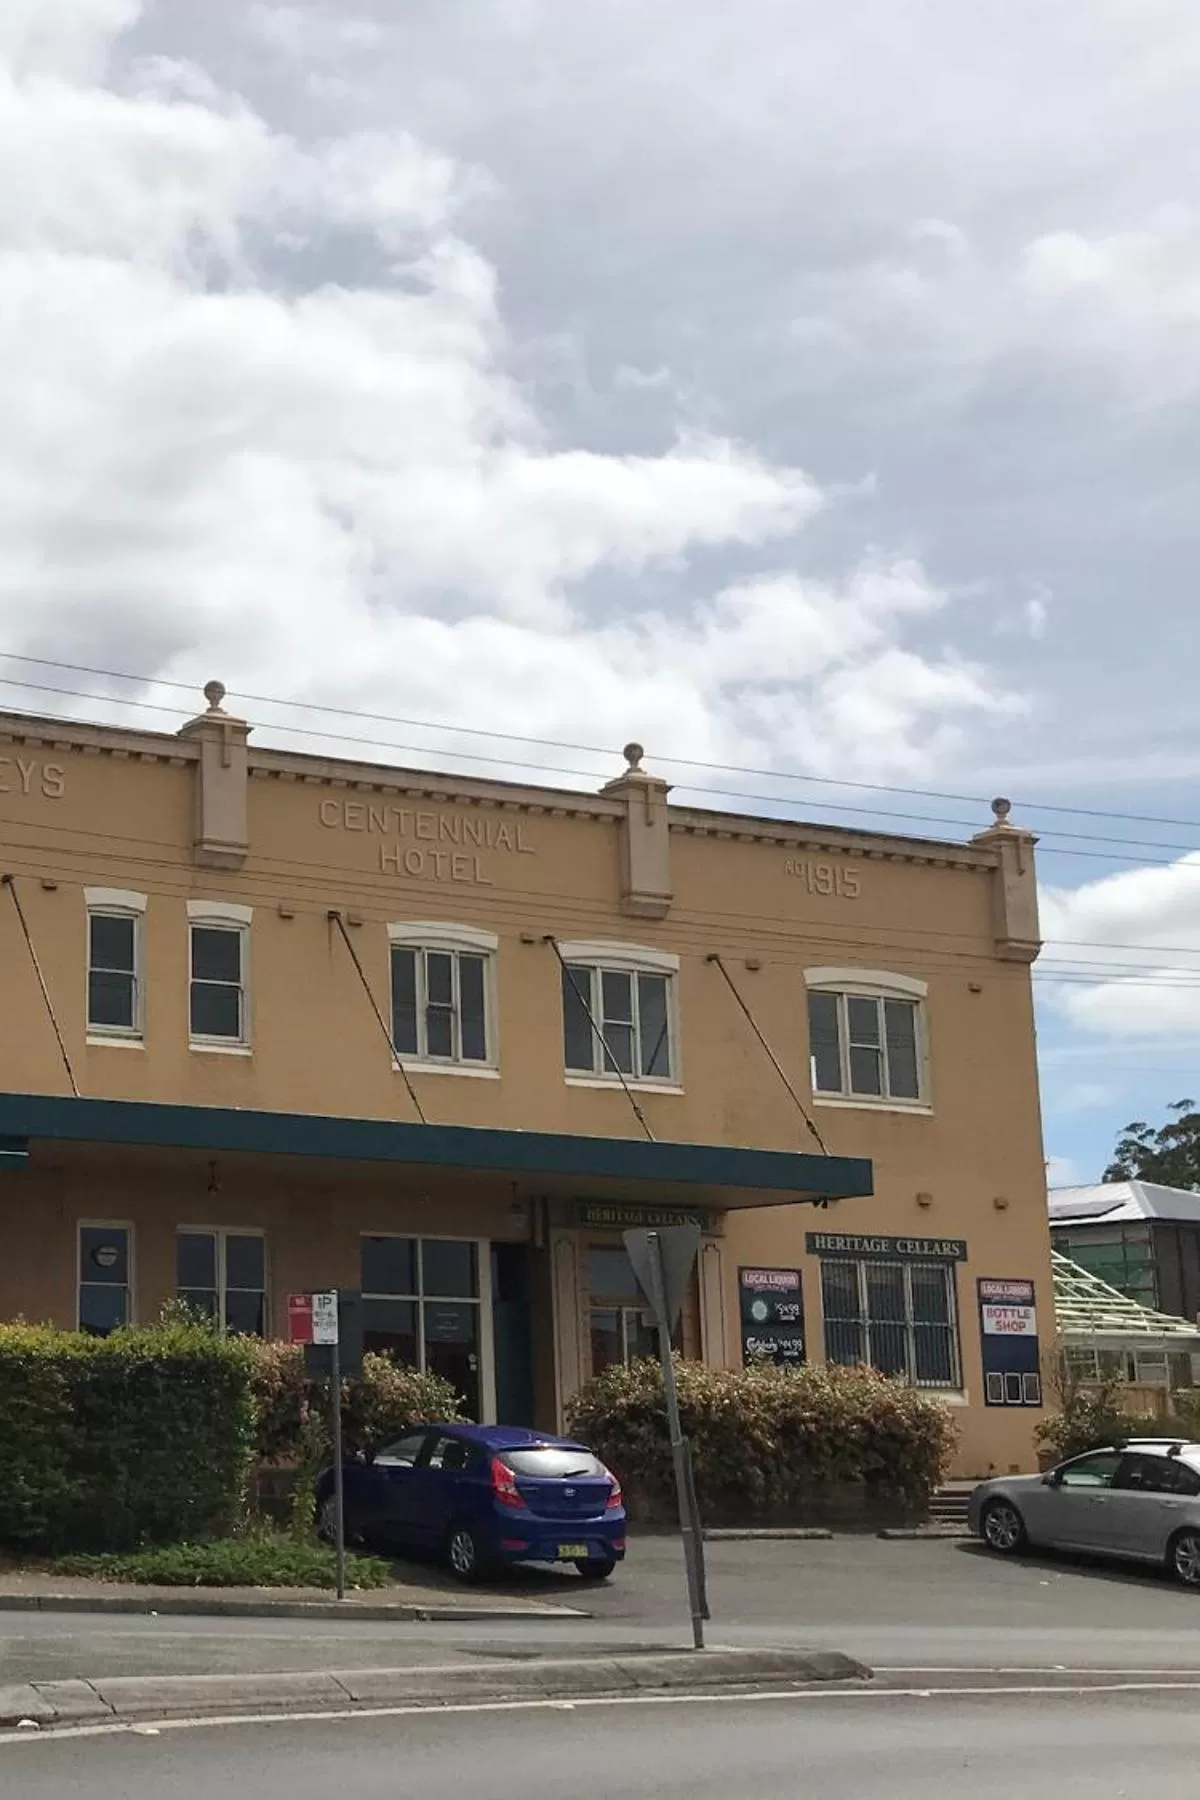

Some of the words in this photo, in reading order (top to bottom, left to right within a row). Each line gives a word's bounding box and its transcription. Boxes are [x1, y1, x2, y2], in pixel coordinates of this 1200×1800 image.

[318, 799, 537, 855] CENTENNIAL
[378, 844, 493, 886] HOTEL
[805, 860, 861, 900] 1915
[814, 1234, 890, 1252] HERITAGE
[895, 1240, 960, 1256] CELLARS
[986, 1307, 1032, 1319] BOTTLE
[995, 1320, 1026, 1332] SHOP
